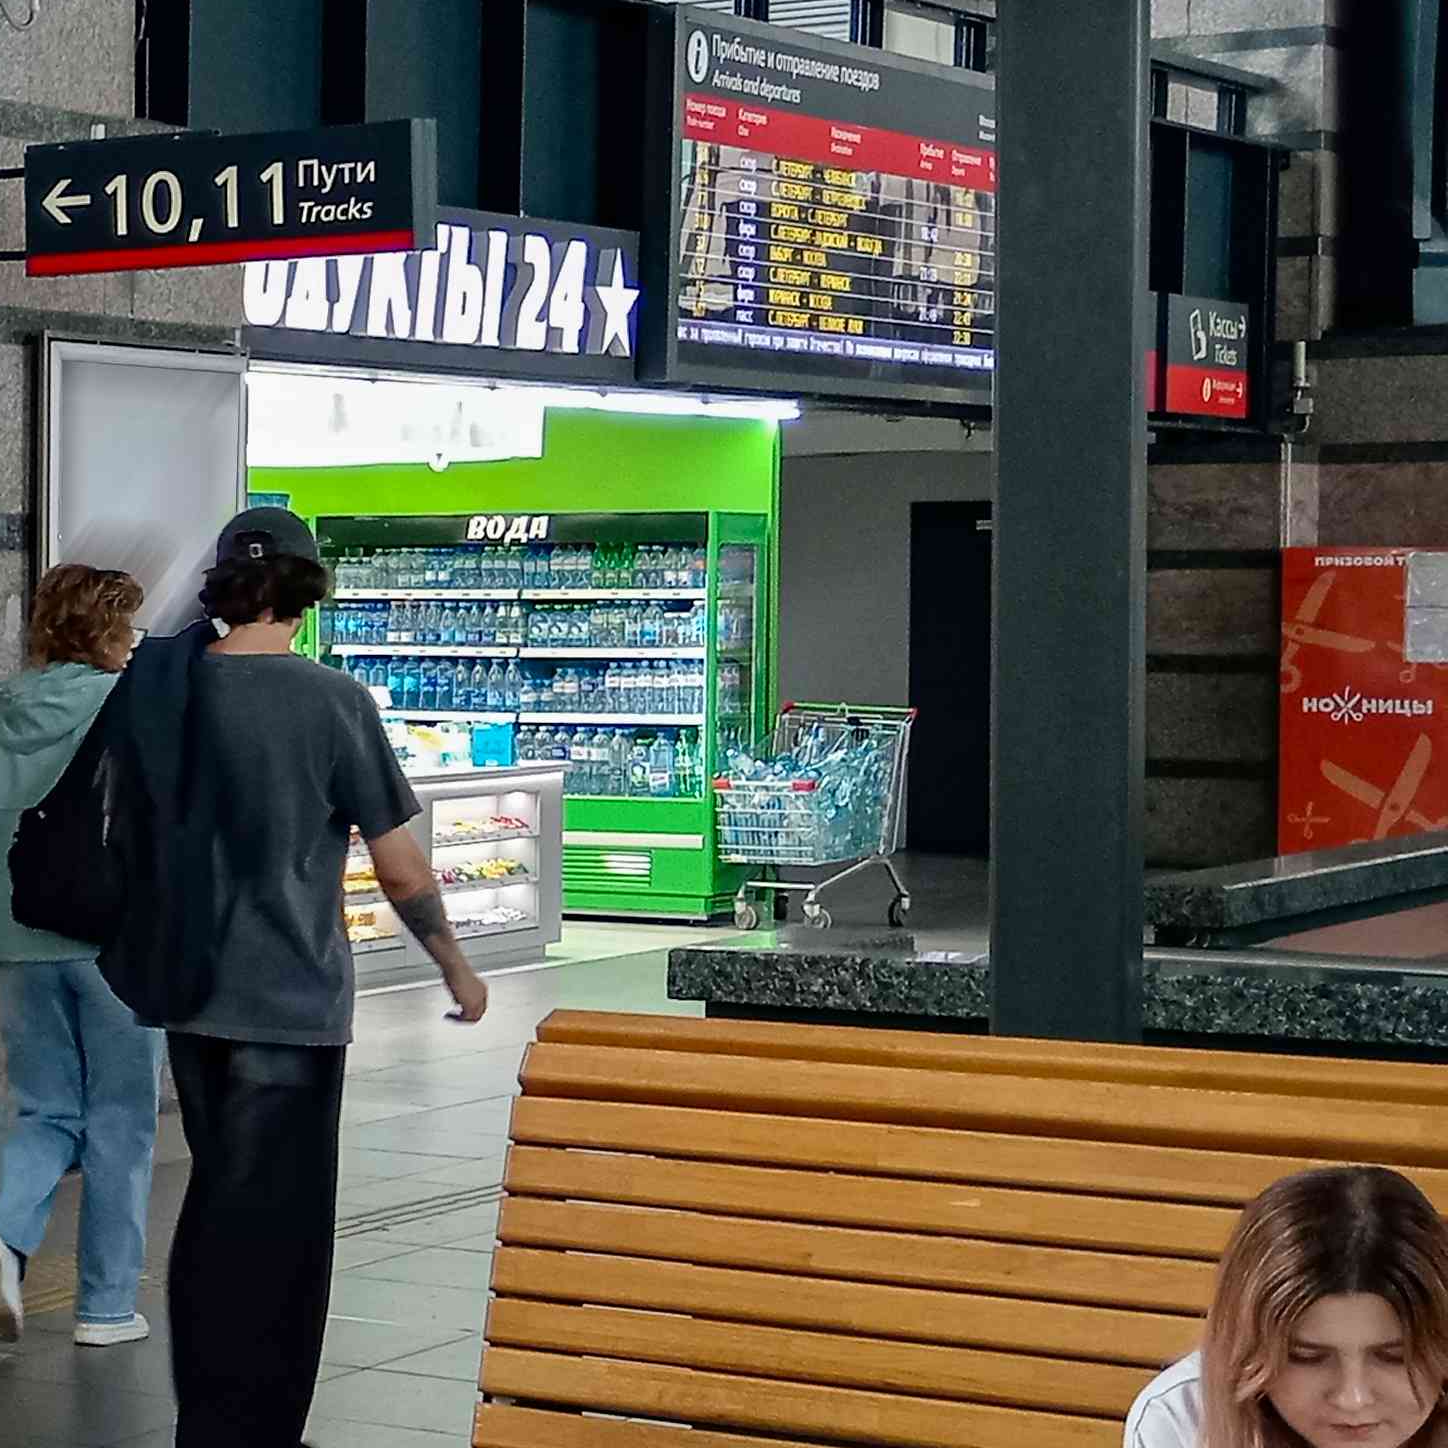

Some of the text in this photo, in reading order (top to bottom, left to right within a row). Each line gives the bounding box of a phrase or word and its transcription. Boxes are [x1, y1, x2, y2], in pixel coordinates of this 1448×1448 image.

[711, 34, 767, 67] Прибытие
[775, 54, 840, 83] отправление
[840, 67, 881, 93] поездов
[712, 70, 802, 104] Arrivals and departures
[296, 156, 377, 190] Пути
[298, 196, 375, 224] Tracks
[515, 233, 588, 355] 24
[1208, 311, 1238, 340] Кассы
[466, 514, 550, 543] ВОДА
[1302, 686, 1434, 724] НОЖНИЦЫ
